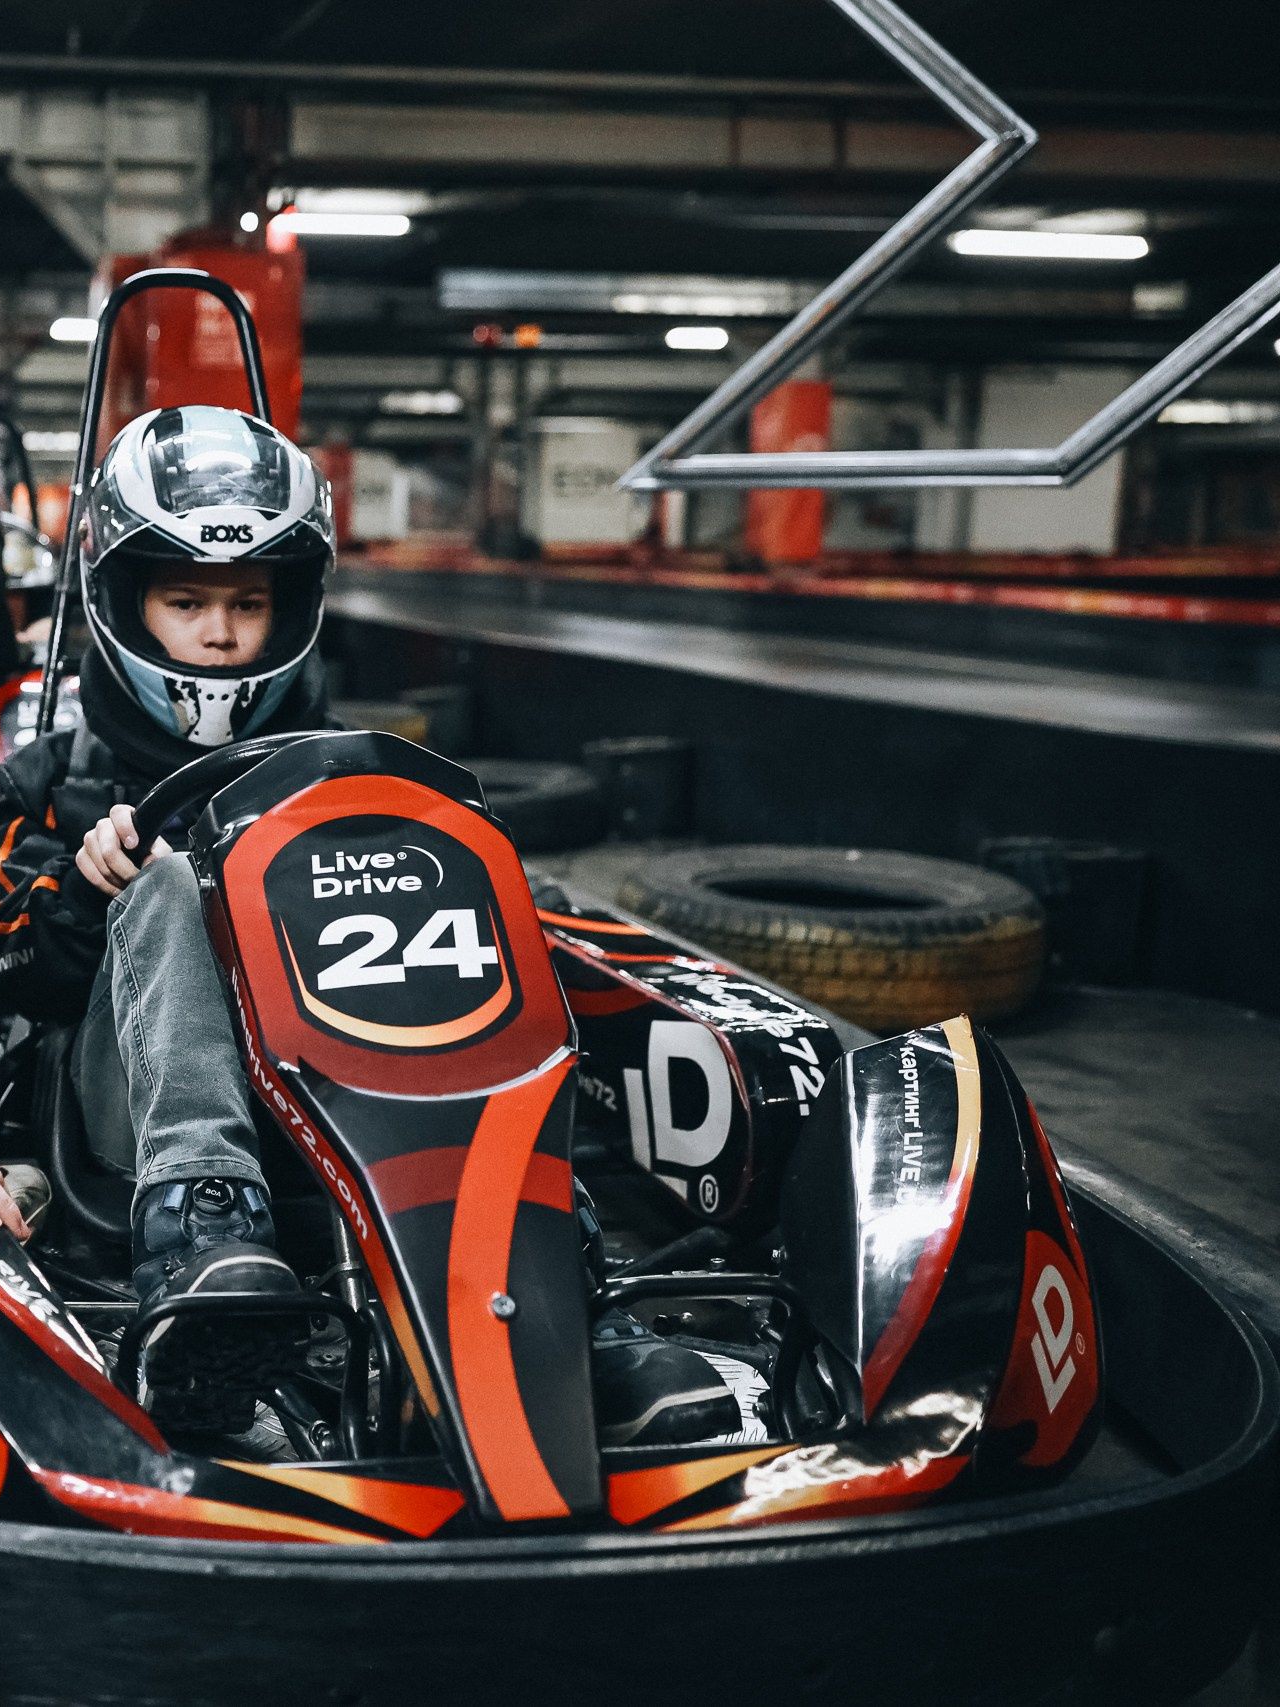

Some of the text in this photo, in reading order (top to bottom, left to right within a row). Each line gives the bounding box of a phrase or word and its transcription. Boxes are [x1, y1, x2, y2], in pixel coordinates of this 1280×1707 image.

[312, 872, 423, 899] Drive
[317, 908, 499, 991] 24
[898, 1047, 920, 1128] картинг
[900, 1132, 923, 1182] LIVE
[205, 1188, 222, 1198] BOA
